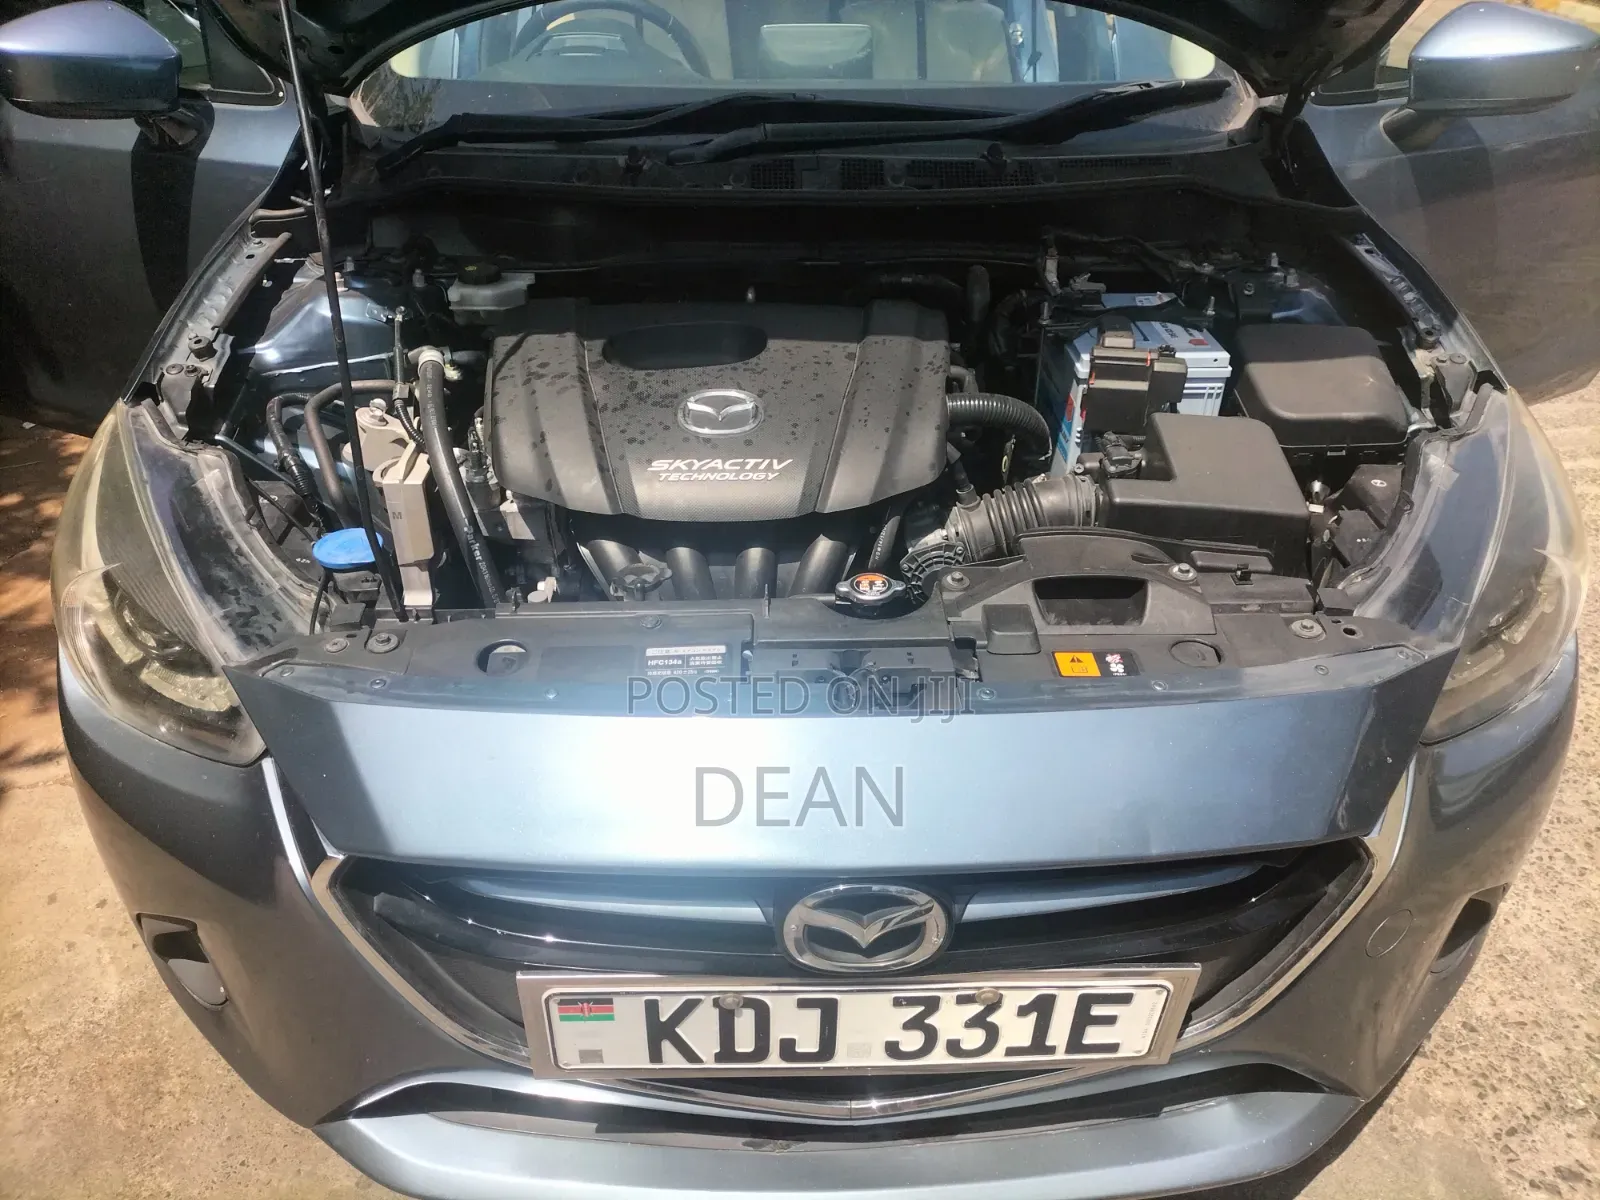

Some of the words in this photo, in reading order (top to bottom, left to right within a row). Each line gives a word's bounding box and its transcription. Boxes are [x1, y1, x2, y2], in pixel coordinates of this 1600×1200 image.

[647, 458, 793, 471] SKYACTIV
[659, 472, 780, 481] TECHNOLOGY
[644, 996, 838, 1063] KDJ
[884, 992, 1135, 1061] 331E
